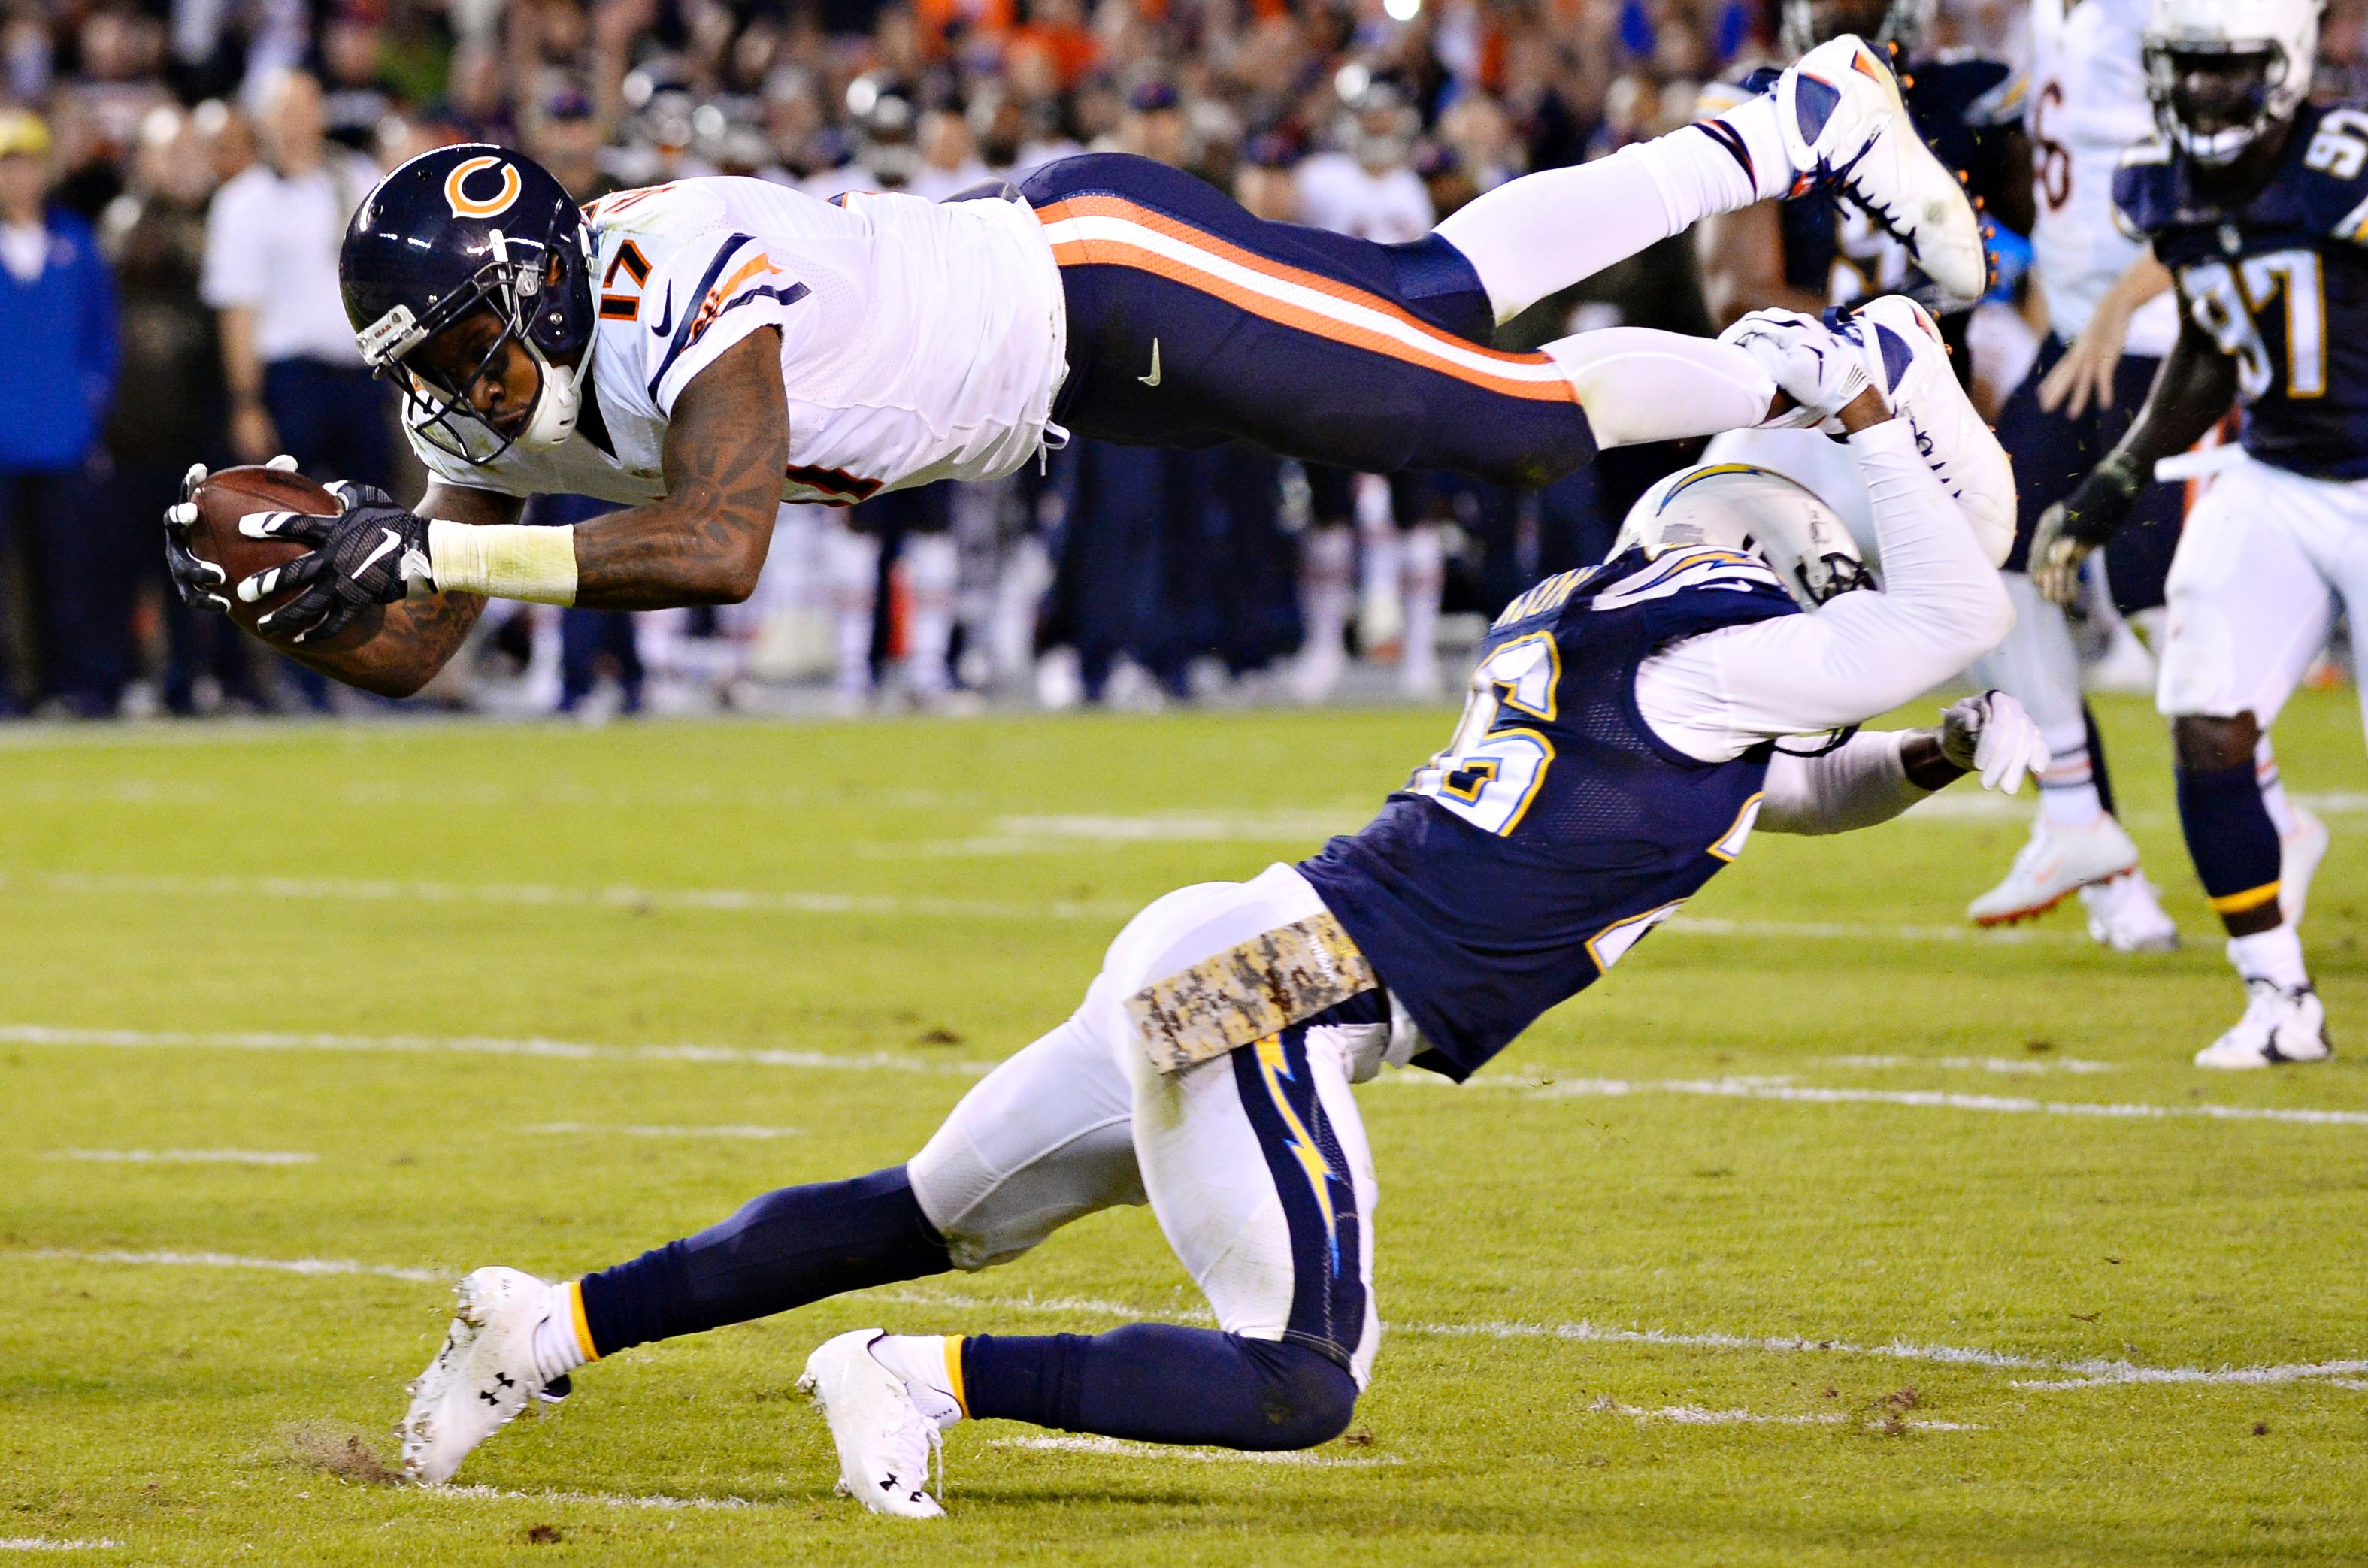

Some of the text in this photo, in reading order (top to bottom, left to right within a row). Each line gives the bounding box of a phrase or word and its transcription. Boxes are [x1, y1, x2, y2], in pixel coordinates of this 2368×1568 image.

[444, 156, 521, 219] C
[599, 239, 653, 321] 17
[2179, 247, 2328, 400] 97
[1407, 630, 1562, 837] 6
